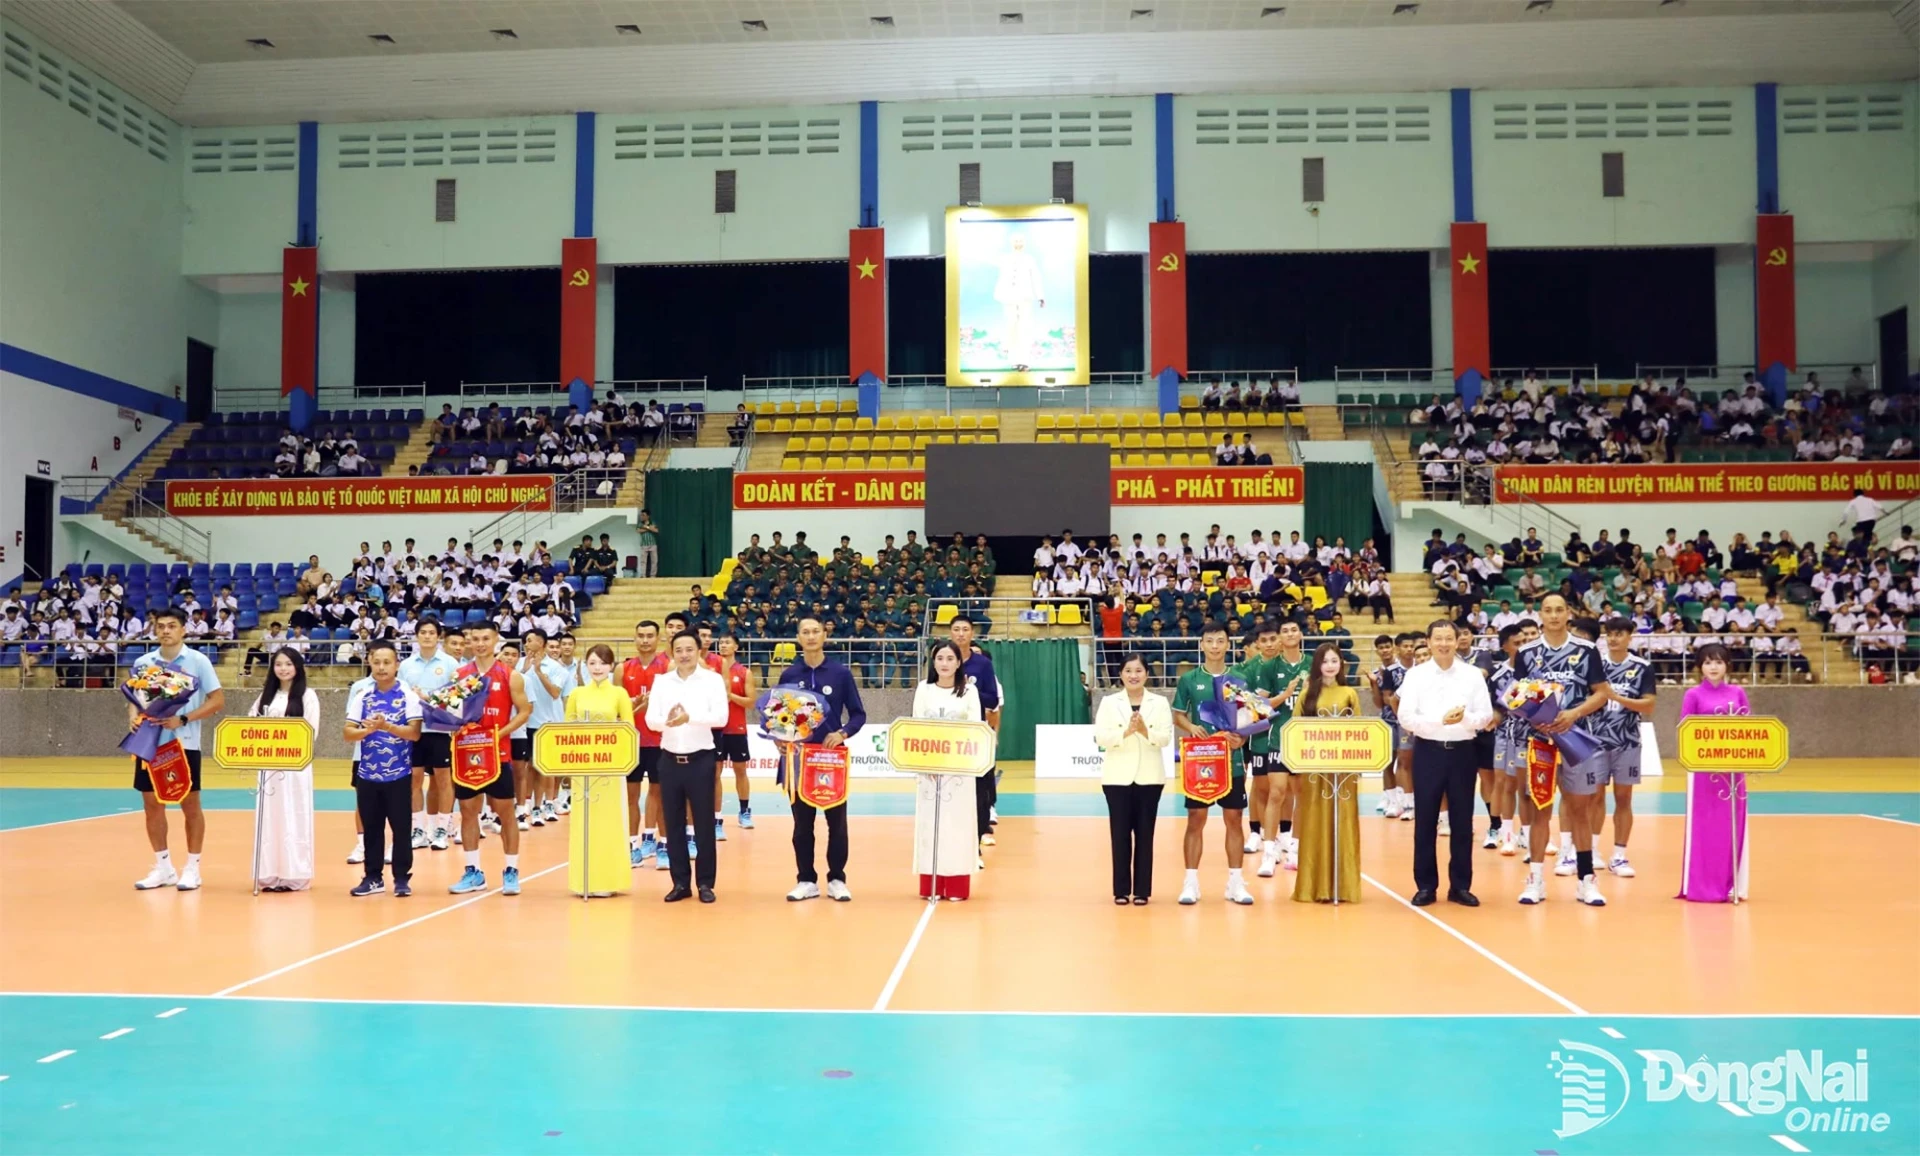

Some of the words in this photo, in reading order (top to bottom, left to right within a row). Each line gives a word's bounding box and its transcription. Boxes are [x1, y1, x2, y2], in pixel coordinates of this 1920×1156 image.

[114, 436, 121, 450] B
[38, 462, 50, 473] WC
[91, 456, 98, 471] A
[743, 480, 796, 503] ĐOÀN
[801, 476, 836, 502] KẾT
[854, 478, 894, 501] DÂN
[900, 481, 925, 501] CH
[1116, 475, 1157, 499] PHÁ
[1175, 474, 1226, 499] PHÁT
[1231, 470, 1295, 498] TRIỂN!
[1503, 474, 1539, 494] TOÀN
[1543, 473, 1573, 494] DÂN
[1576, 473, 1605, 494] RÈN
[1609, 473, 1653, 497] LUYỆN
[1657, 472, 1694, 493] THÂN
[1698, 470, 1725, 493] THỂ
[1728, 475, 1763, 492] THEO
[1768, 473, 1816, 492] GƯƠNG
[1820, 471, 1850, 491] BÁC
[1854, 468, 1873, 490] HỒ
[1878, 470, 1892, 490] VĨ
[173, 487, 202, 508] KHỎE
[205, 486, 220, 507] ĐỂ
[222, 488, 243, 507] XÂY
[246, 490, 277, 511] DỰNG
[279, 488, 295, 506] VÀ
[297, 486, 319, 507] BẢO
[322, 487, 337, 509] VỆ
[338, 485, 354, 506] TỔ
[356, 485, 385, 507] QUỐC
[388, 486, 412, 508] VIỆT
[414, 488, 441, 505] NAM
[444, 486, 460, 504] XÃ
[463, 485, 481, 507] HỘI
[485, 483, 508, 503] CHỦ
[511, 484, 546, 503] NGHĨA
[16, 531, 23, 546] F
[241, 727, 269, 740] CÔNG
[272, 729, 288, 740] AN
[555, 732, 591, 746] THÀNH
[595, 730, 618, 745] PHỐ
[1303, 728, 1342, 742] THÀNH
[1345, 726, 1370, 741] PHỐ
[1694, 726, 1714, 742] ĐỘI
[1718, 729, 1769, 740] VISAKHA
[226, 746, 238, 757] TP.
[257, 745, 273, 757] CHÍ
[276, 747, 302, 758] MINH
[903, 737, 951, 756] TRỌNG
[955, 738, 978, 756] TÀI
[1319, 747, 1338, 760] CHÍ
[1341, 748, 1372, 760] MINH
[1697, 748, 1766, 759] CAMPUCHIA
[561, 750, 590, 764] ĐỒNG
[593, 752, 612, 763] NAI
[1253, 756, 1263, 767] 10
[1586, 772, 1596, 785] 15
